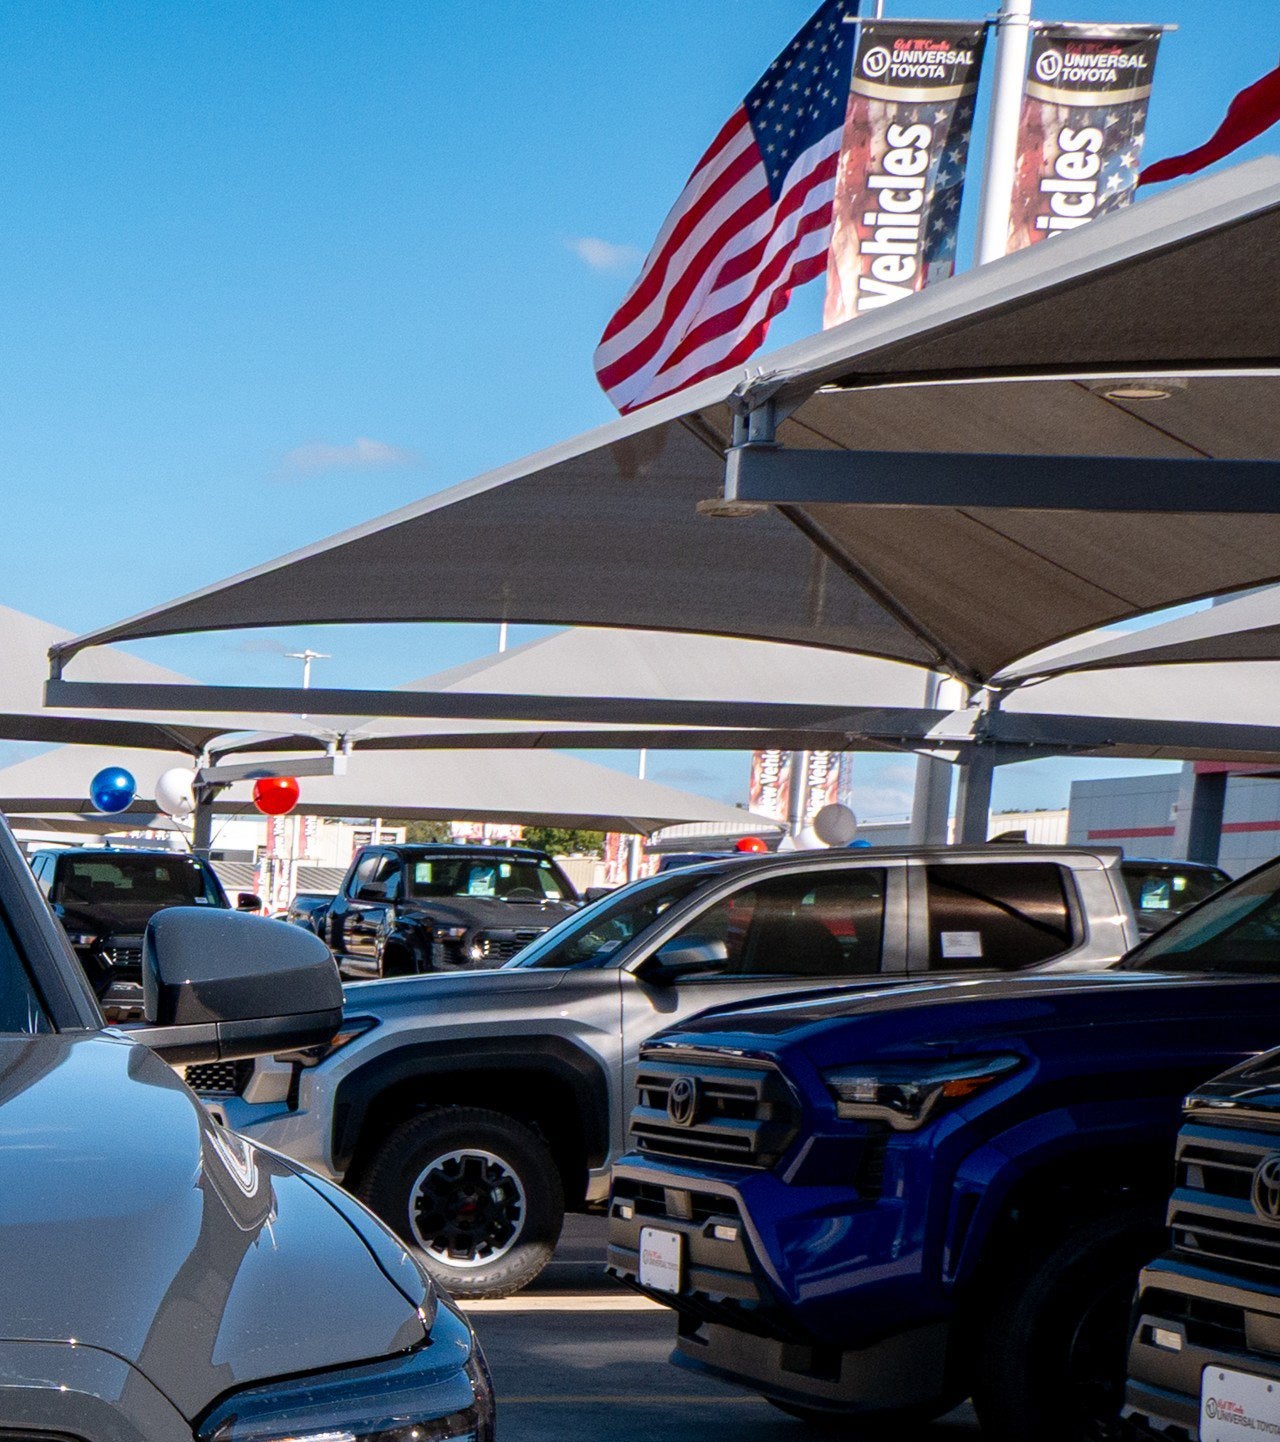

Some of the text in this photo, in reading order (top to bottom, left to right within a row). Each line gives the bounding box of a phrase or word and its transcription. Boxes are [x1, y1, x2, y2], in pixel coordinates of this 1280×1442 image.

[892, 50, 974, 65] UNIVERSAL
[1064, 53, 1148, 69] UNIVERSAL
[890, 65, 945, 78] TOYOTA
[1061, 68, 1117, 82] TOYOTA
[1036, 127, 1103, 238] icles
[857, 123, 932, 310] Vehicles
